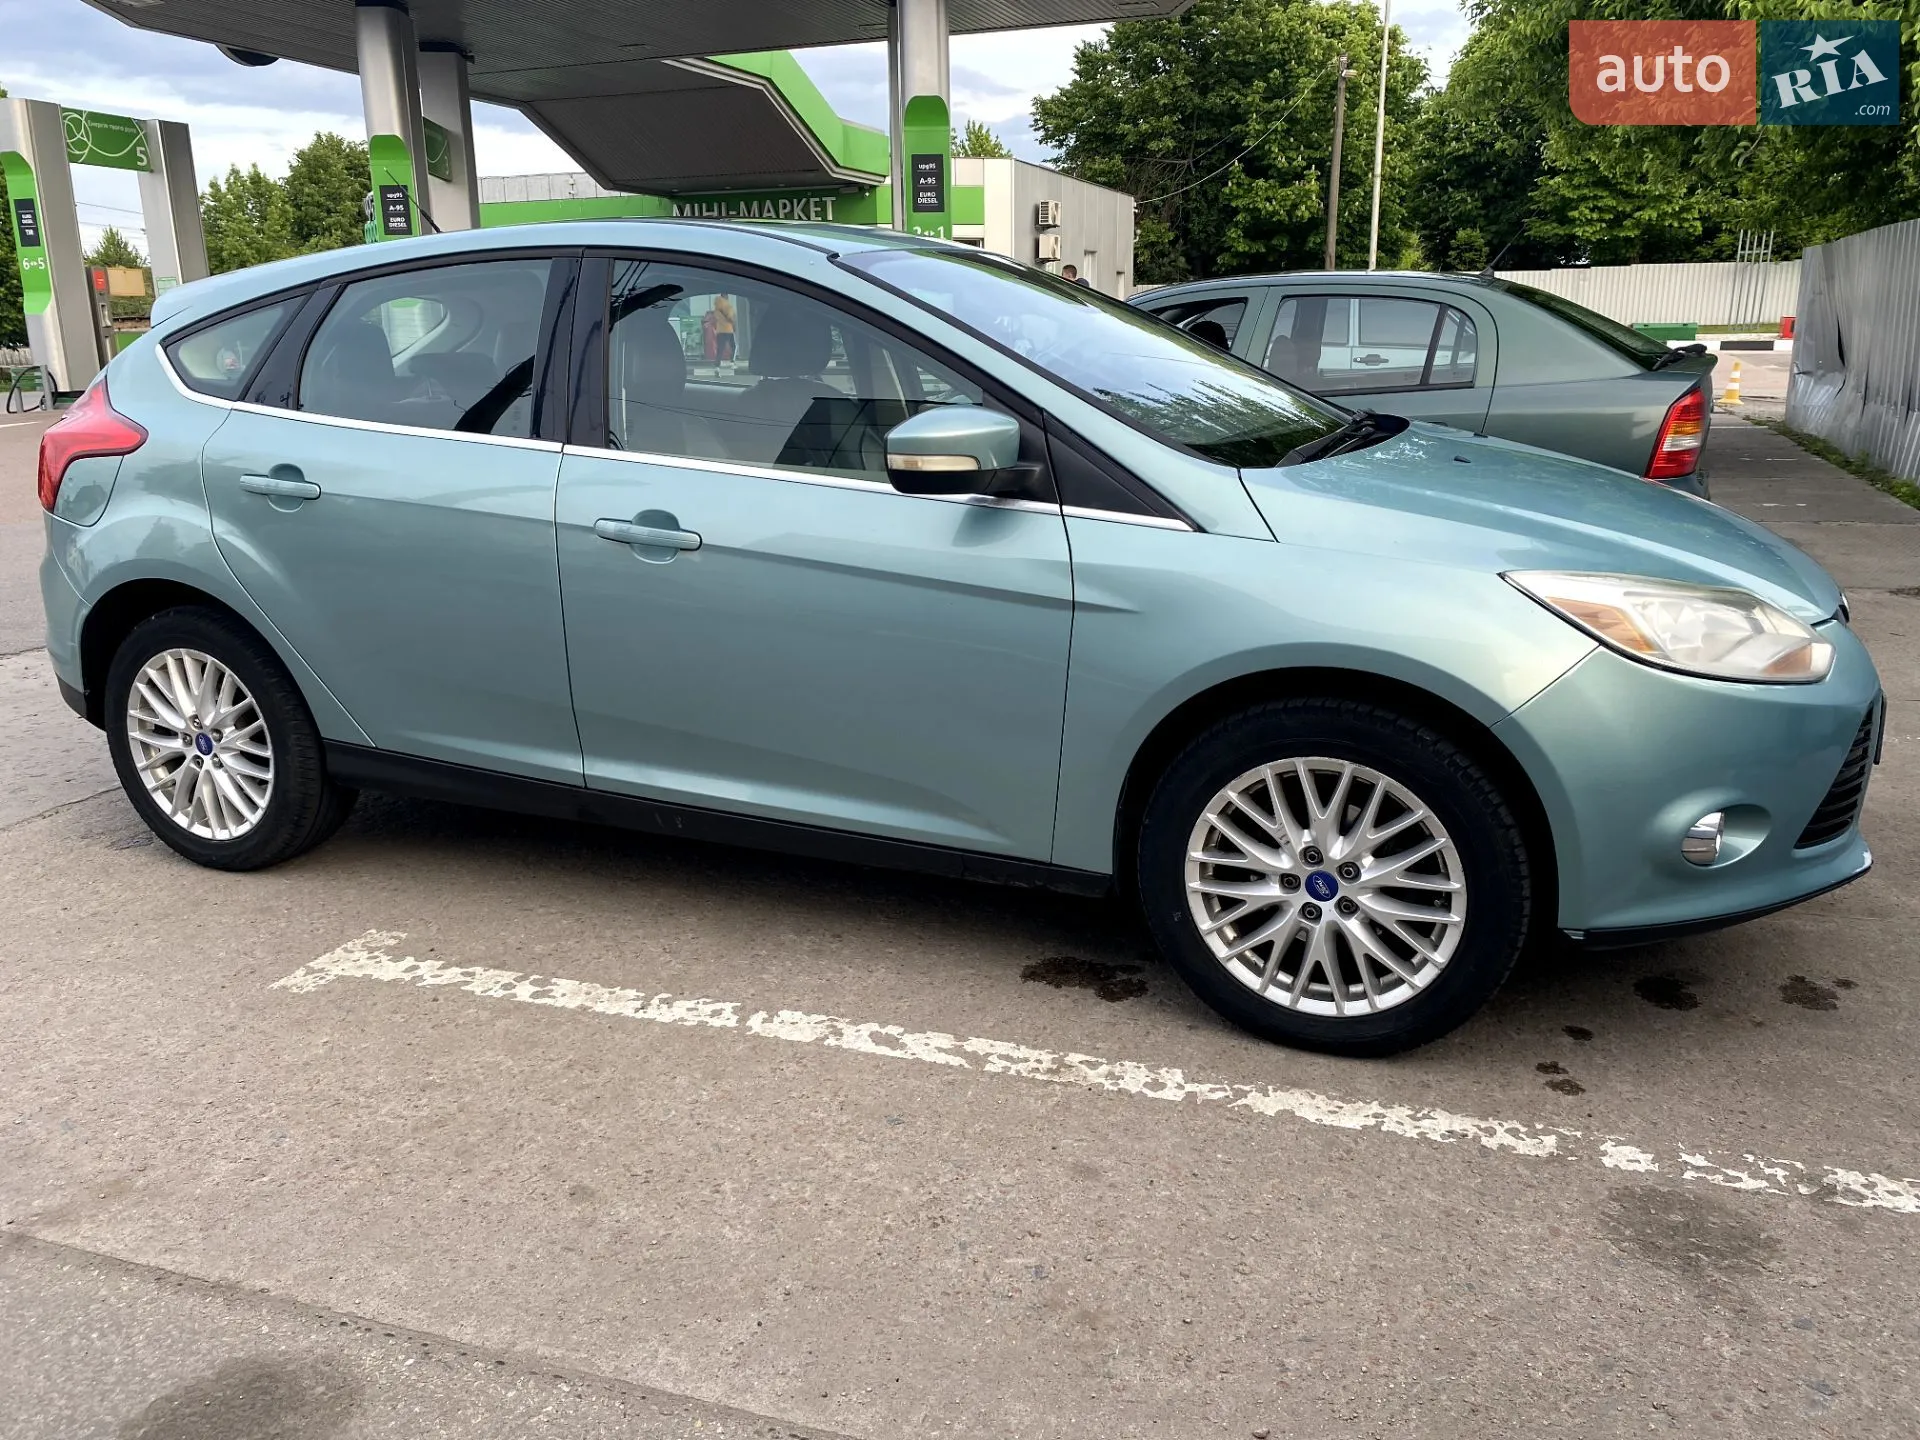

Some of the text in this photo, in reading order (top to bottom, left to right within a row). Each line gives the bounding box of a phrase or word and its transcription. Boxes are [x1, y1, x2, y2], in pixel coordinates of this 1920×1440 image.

[136, 147, 148, 167] 5
[919, 177, 936, 185] A-95
[937, 226, 946, 240] 1
[22, 257, 45, 271] 6 5
